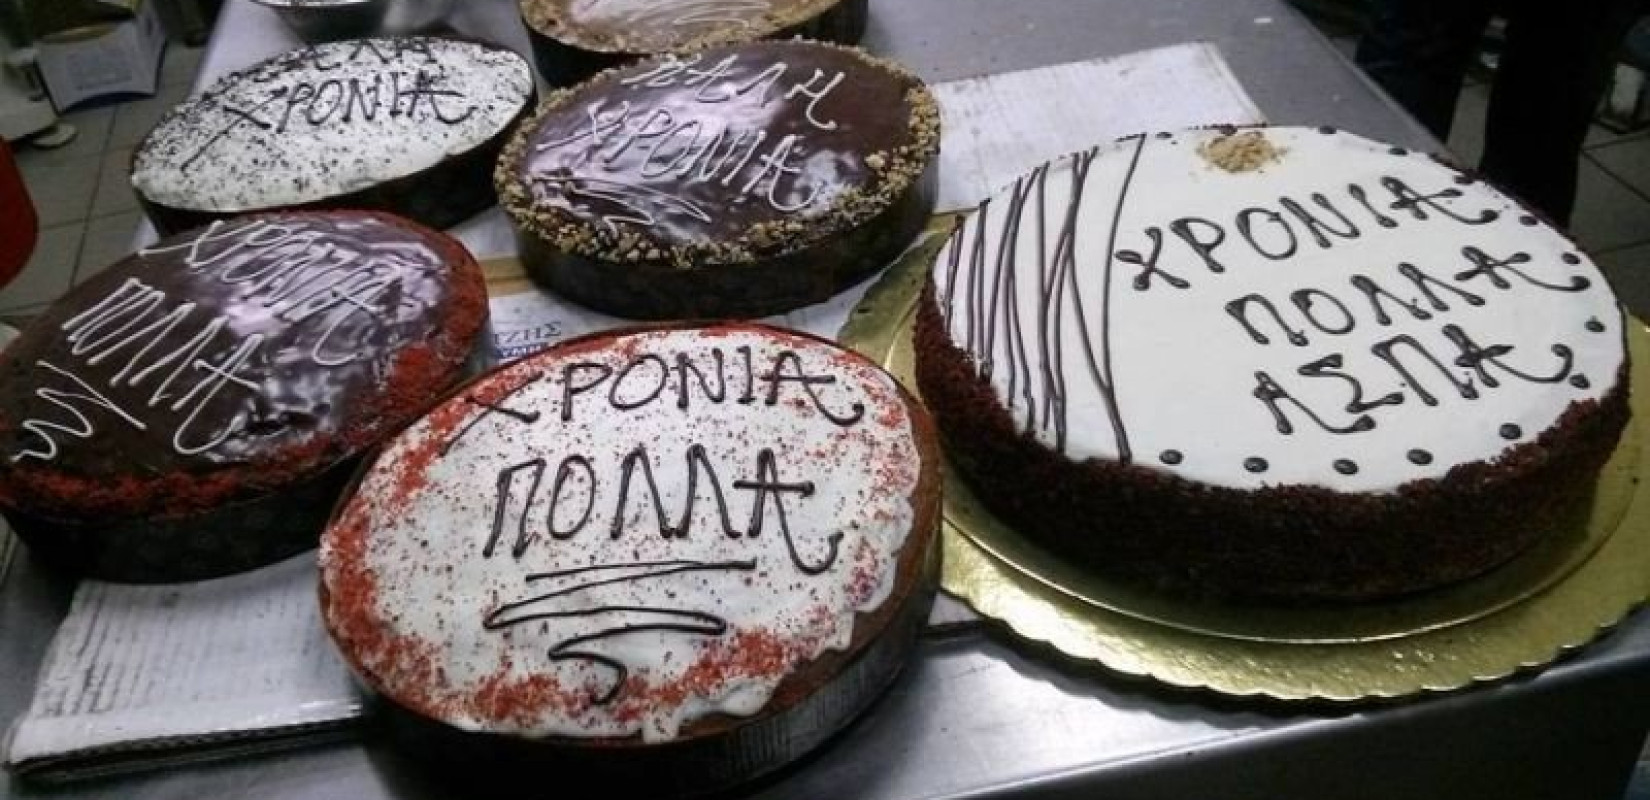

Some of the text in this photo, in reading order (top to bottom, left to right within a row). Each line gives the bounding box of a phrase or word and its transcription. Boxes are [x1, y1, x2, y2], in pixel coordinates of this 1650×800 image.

[1114, 176, 1499, 291] ΧΡΟΝΙΑ
[1225, 245, 1591, 346] ΠΟΛΛΑ
[440, 346, 865, 456] ΧΡΟΝΙΑ
[483, 443, 844, 575] ΠΟΛΛΑ
